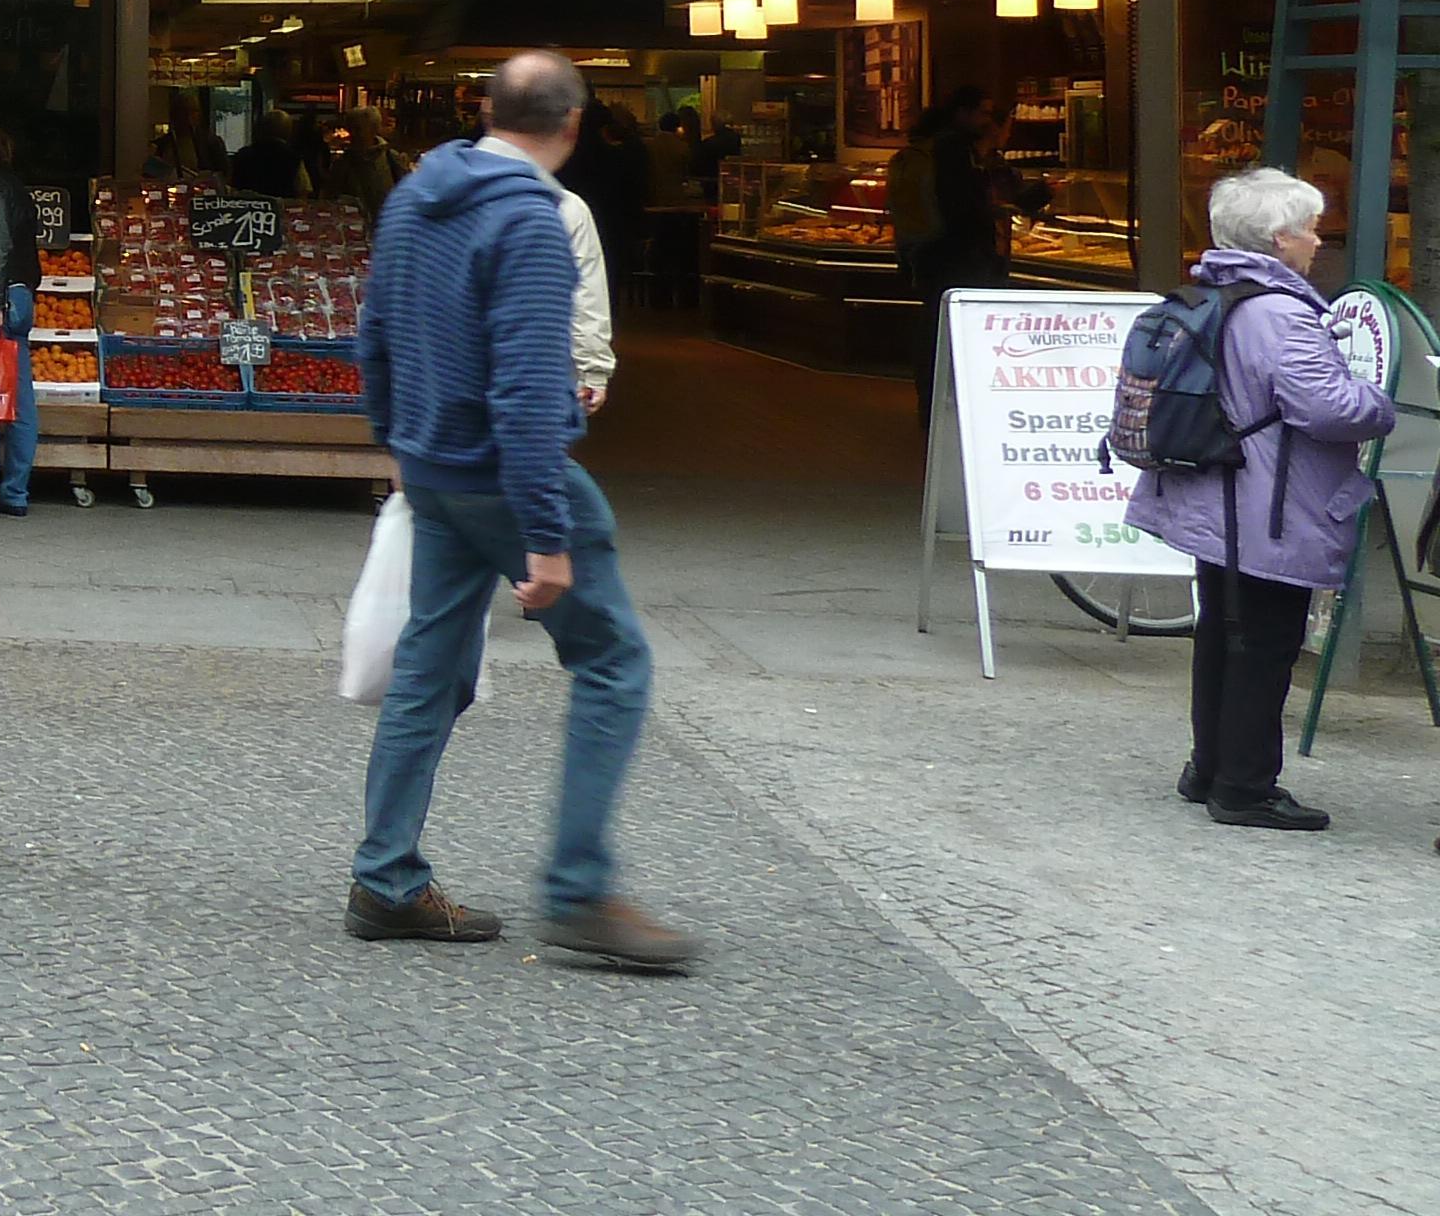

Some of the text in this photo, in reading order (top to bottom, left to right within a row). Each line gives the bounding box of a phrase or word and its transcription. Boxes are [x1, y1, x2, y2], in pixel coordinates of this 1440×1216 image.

[984, 312, 1116, 331] Fränkel's
[1028, 331, 1117, 346] WÜRSTCHEN
[1008, 410, 1111, 433] Sparge
[1024, 481, 1132, 502] 6 Stück
[1008, 529, 1052, 543] nur
[1075, 522, 1141, 548] 3,50
